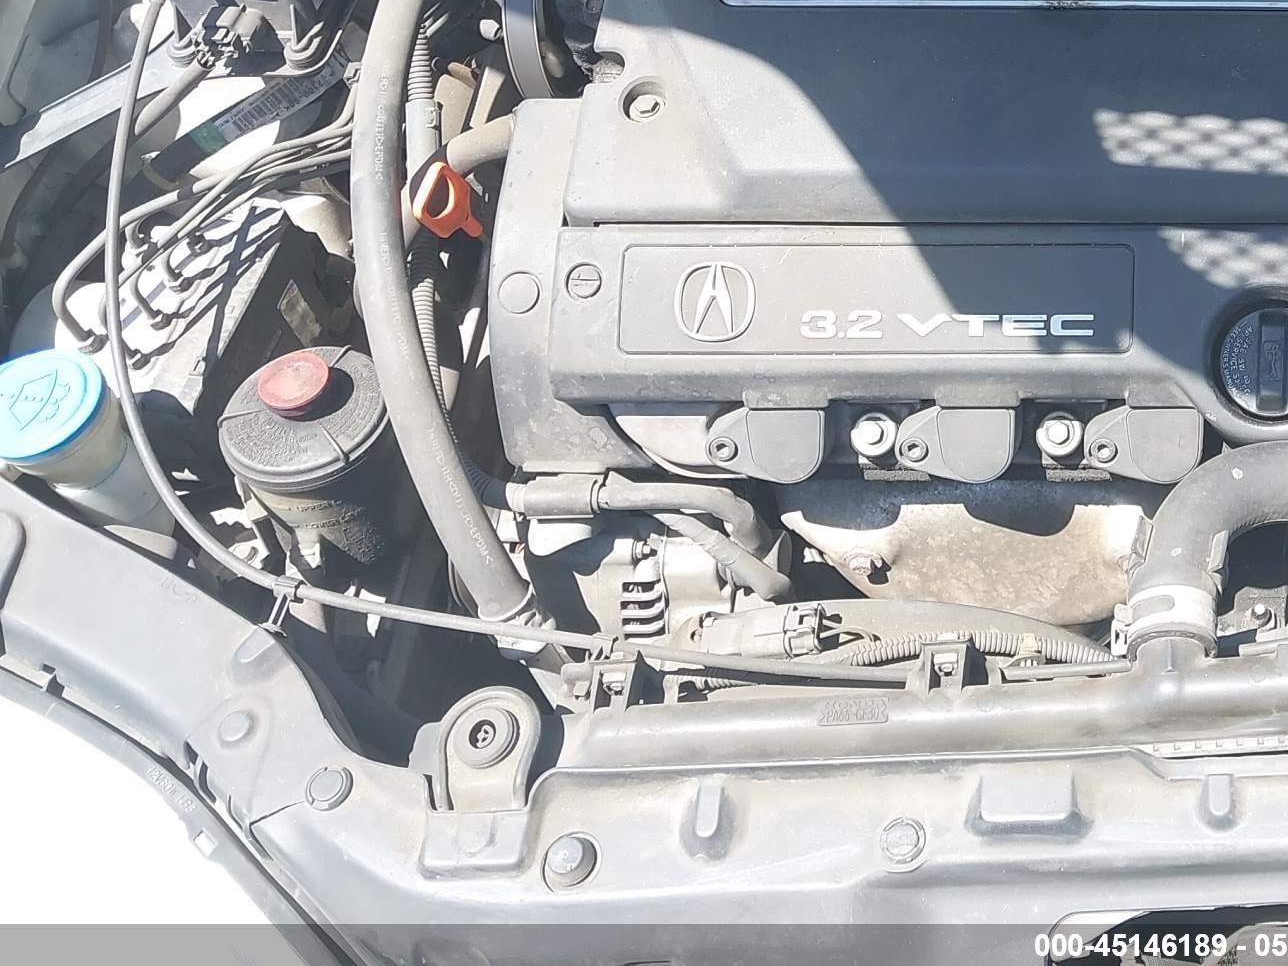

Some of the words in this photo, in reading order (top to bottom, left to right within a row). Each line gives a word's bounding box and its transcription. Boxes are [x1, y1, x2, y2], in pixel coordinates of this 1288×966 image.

[799, 309, 884, 339] 3.2
[896, 312, 1095, 338] VTEC
[1229, 336, 1243, 370] SERVICE
